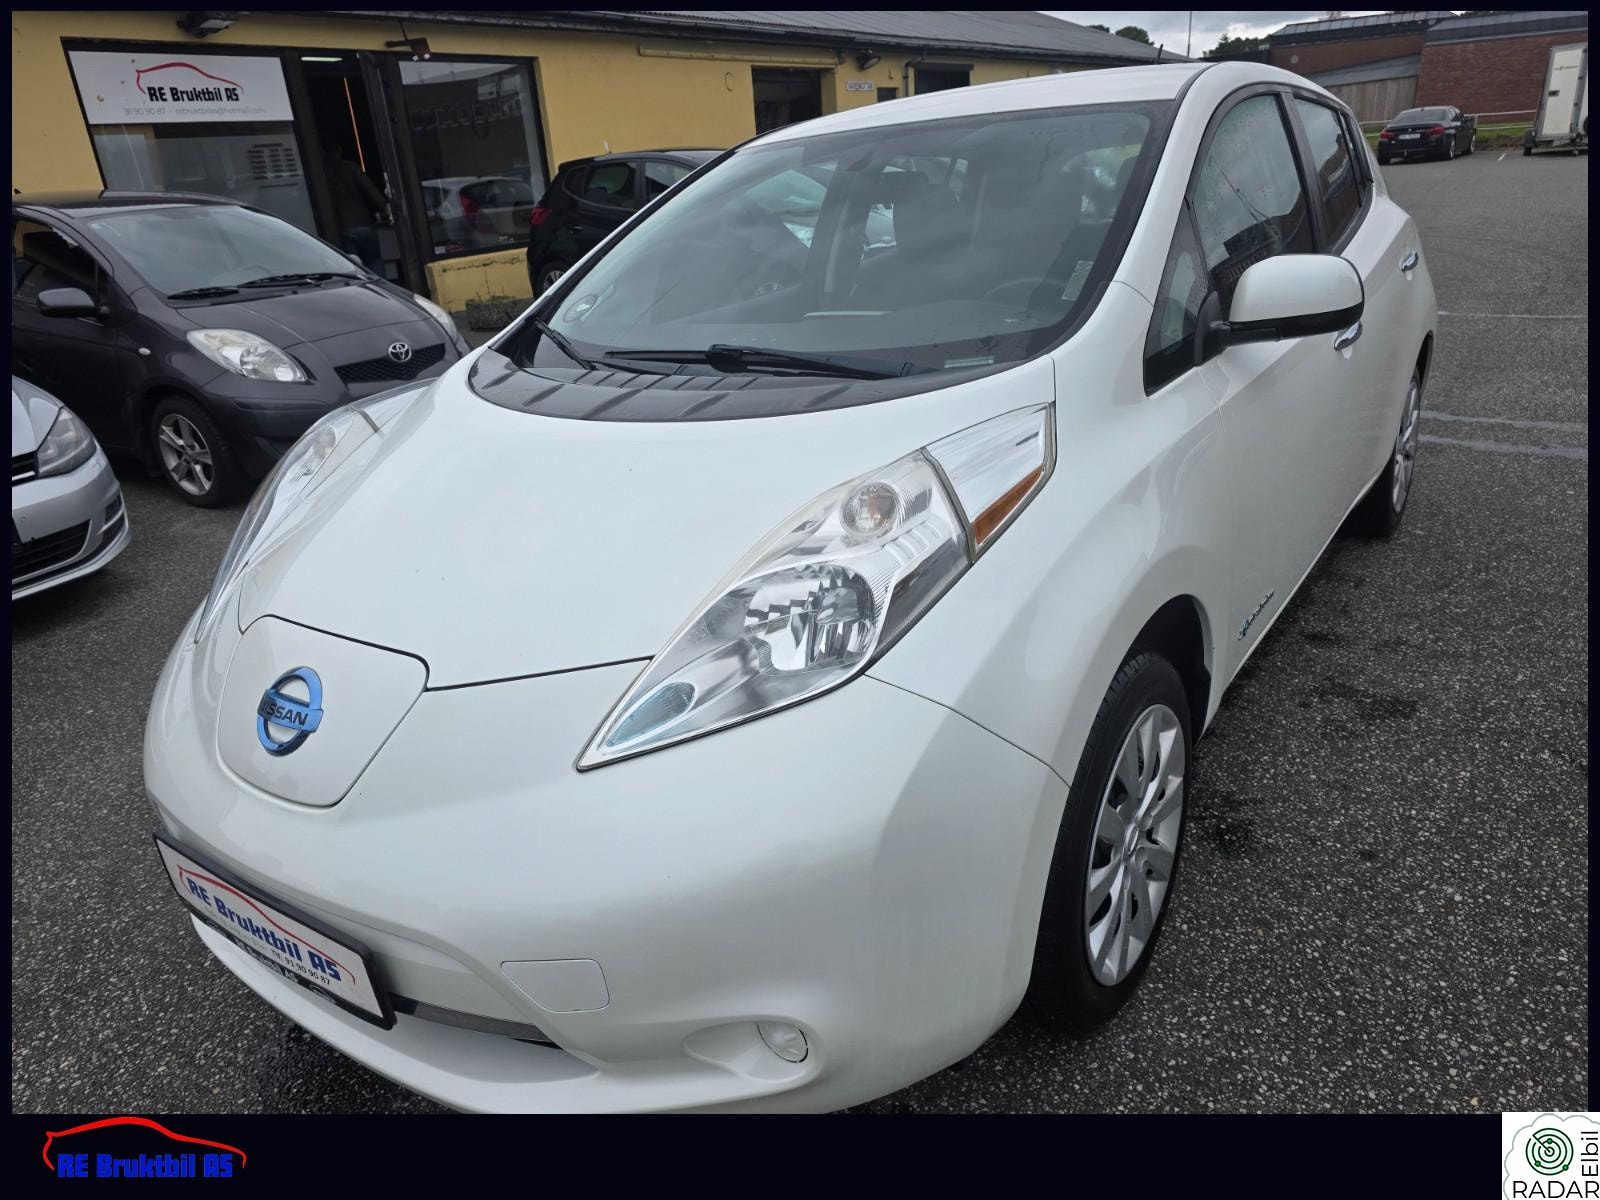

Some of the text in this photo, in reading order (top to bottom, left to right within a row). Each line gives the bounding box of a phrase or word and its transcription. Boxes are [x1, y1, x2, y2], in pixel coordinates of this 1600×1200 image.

[147, 87, 239, 101] RE Bruktbil AS
[261, 699, 309, 726] NISSAN
[186, 877, 212, 906] RE
[214, 896, 302, 962] Bruktbil
[307, 950, 342, 982] AS
[308, 969, 319, 979] 90
